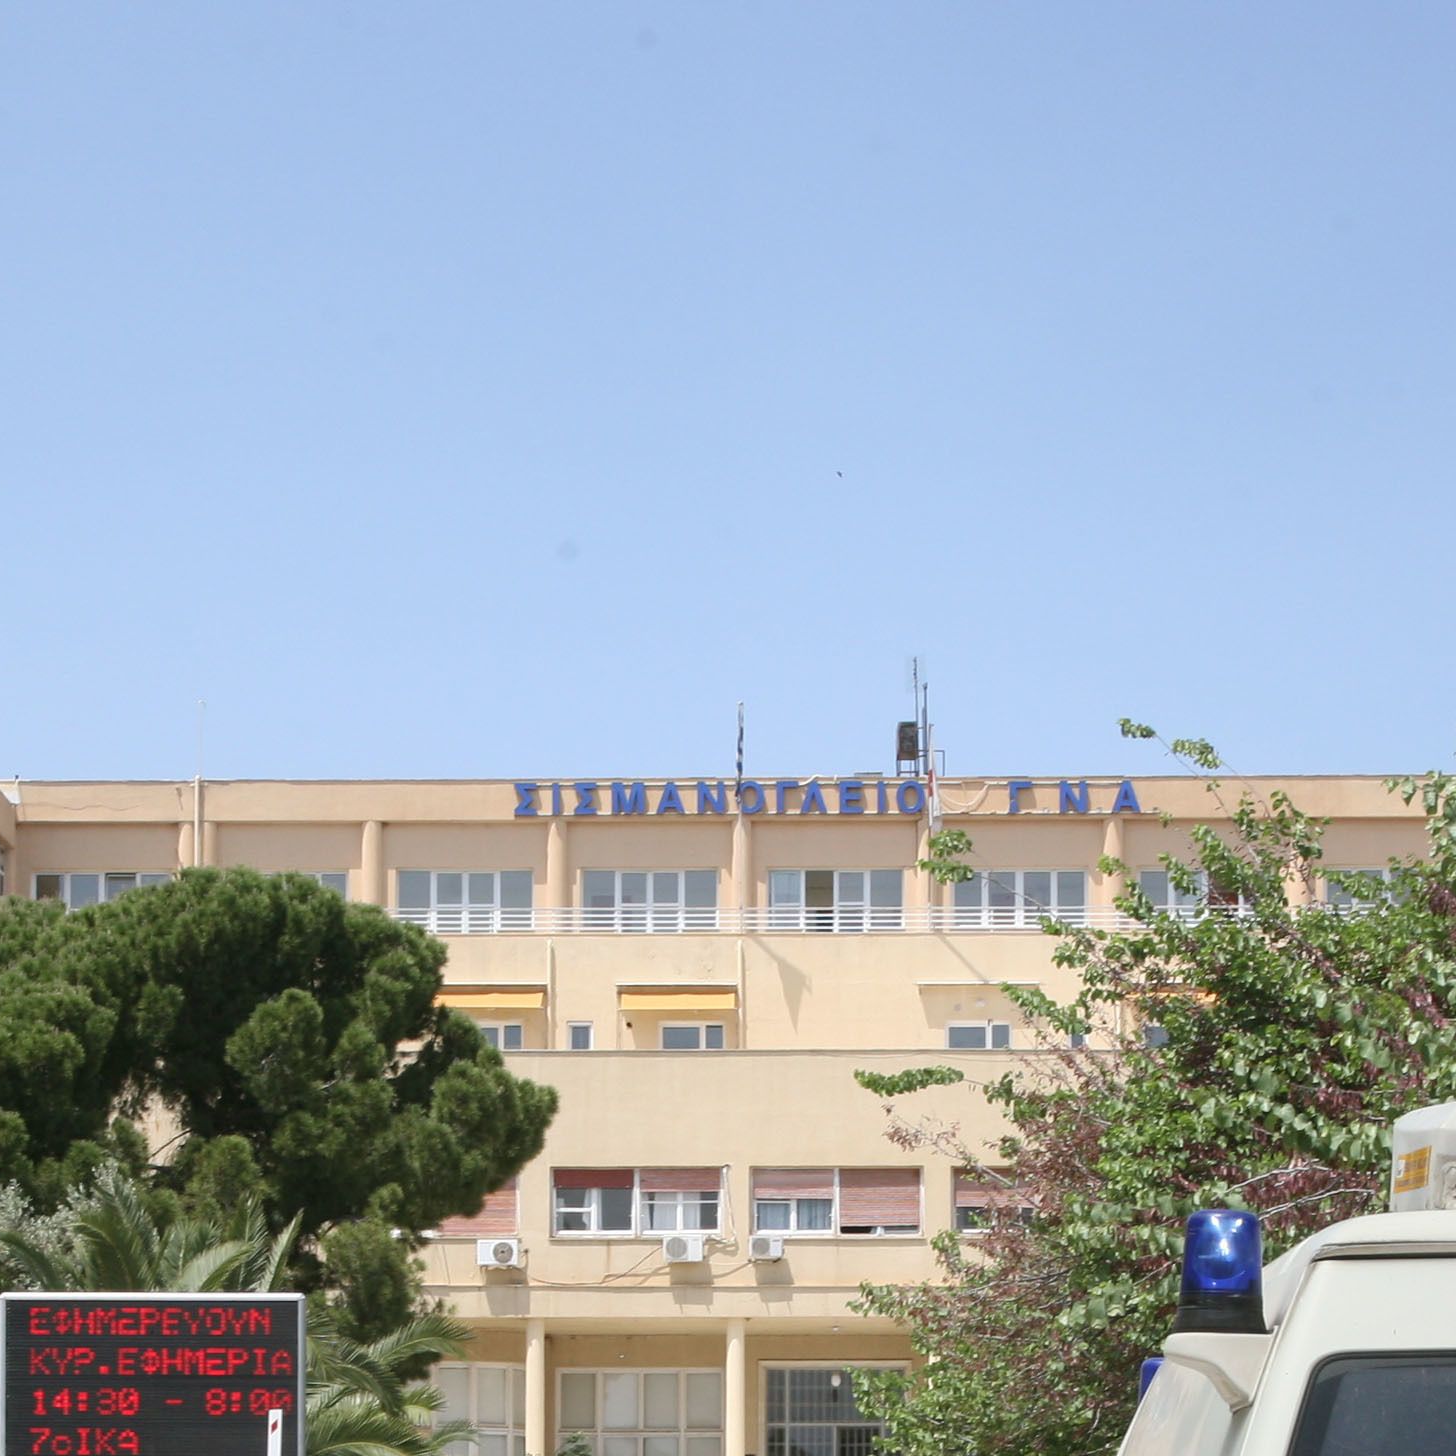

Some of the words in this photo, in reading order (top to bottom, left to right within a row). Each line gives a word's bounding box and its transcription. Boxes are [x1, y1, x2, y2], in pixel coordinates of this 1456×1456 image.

[514, 781, 926, 816] ΣΙΣΜΑΝΟΓΛΕΙΟ
[29, 1307, 272, 1335] ΕΦΗΜΕΡΕΥΟΥΝ
[33, 1387, 141, 1416] 14:30
[205, 1387, 293, 1416] 8:00
